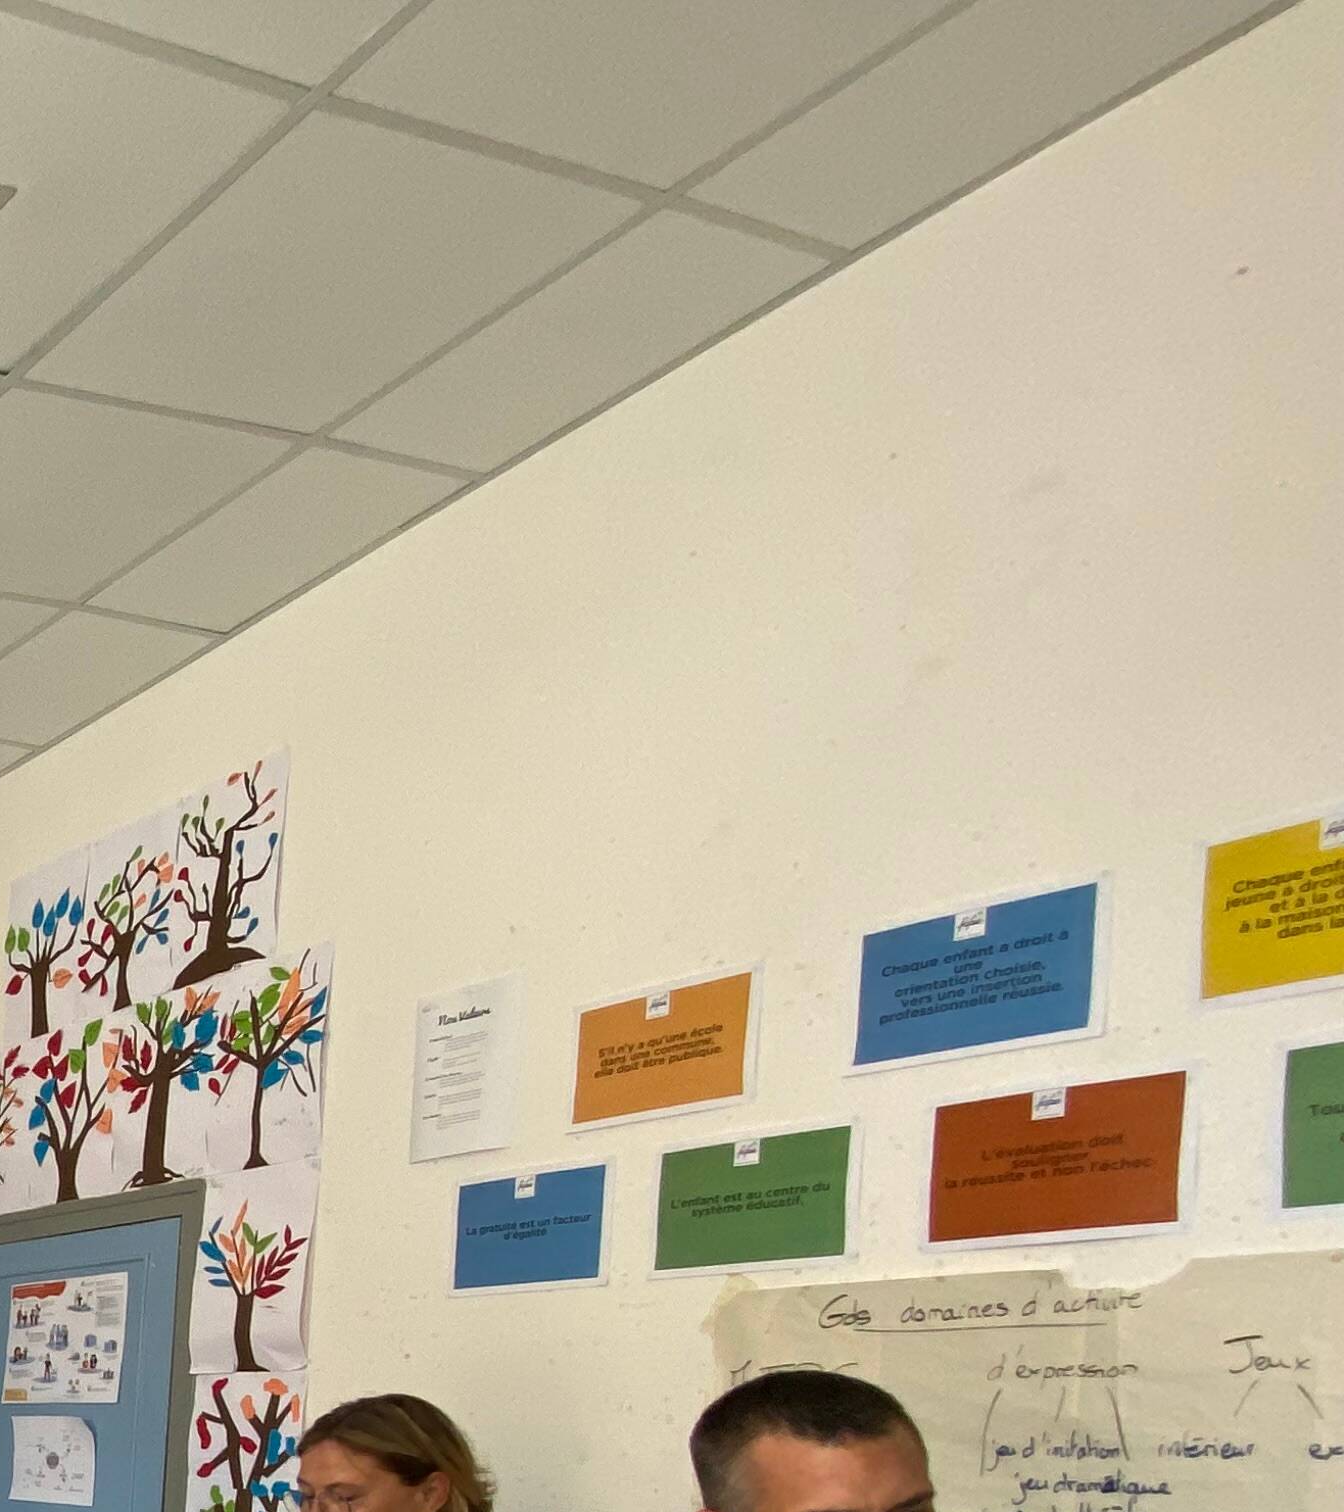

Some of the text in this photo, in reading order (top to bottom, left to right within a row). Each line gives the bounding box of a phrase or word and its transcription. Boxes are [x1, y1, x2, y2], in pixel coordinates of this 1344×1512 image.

[1233, 858, 1344, 893] Chaque enf
[1225, 891, 1276, 911] jeune
[1300, 874, 1344, 892] droi
[1277, 922, 1324, 938] dans
[881, 957, 938, 977] Chaque
[943, 945, 993, 964] enfant
[1014, 933, 1054, 950] droit
[954, 960, 982, 973] une
[894, 974, 979, 997] orientation
[901, 974, 1042, 1008] vers une insertion
[879, 994, 997, 1025] professionnelle
[648, 1031, 687, 1047] qu'une
[690, 1023, 723, 1036] école
[600, 1056, 626, 1067] dans
[631, 1051, 650, 1061] une
[617, 1062, 640, 1073] doit
[642, 1057, 664, 1068] être
[1088, 1133, 1124, 1148] doit
[1012, 1152, 1089, 1169] souligner
[1030, 1168, 1046, 1179] et
[1052, 1165, 1084, 1177] non
[723, 1192, 742, 1202] est
[746, 1190, 761, 1199] au
[765, 1184, 809, 1198] centre
[812, 1182, 830, 1192] du
[691, 1202, 741, 1218] système
[520, 1220, 535, 1229] est
[538, 1218, 550, 1226] un
[553, 1214, 592, 1225] facteur
[900, 1299, 1009, 1326] domaines
[1223, 1335, 1312, 1375] Jeux
[1308, 1440, 1344, 1461] ex
